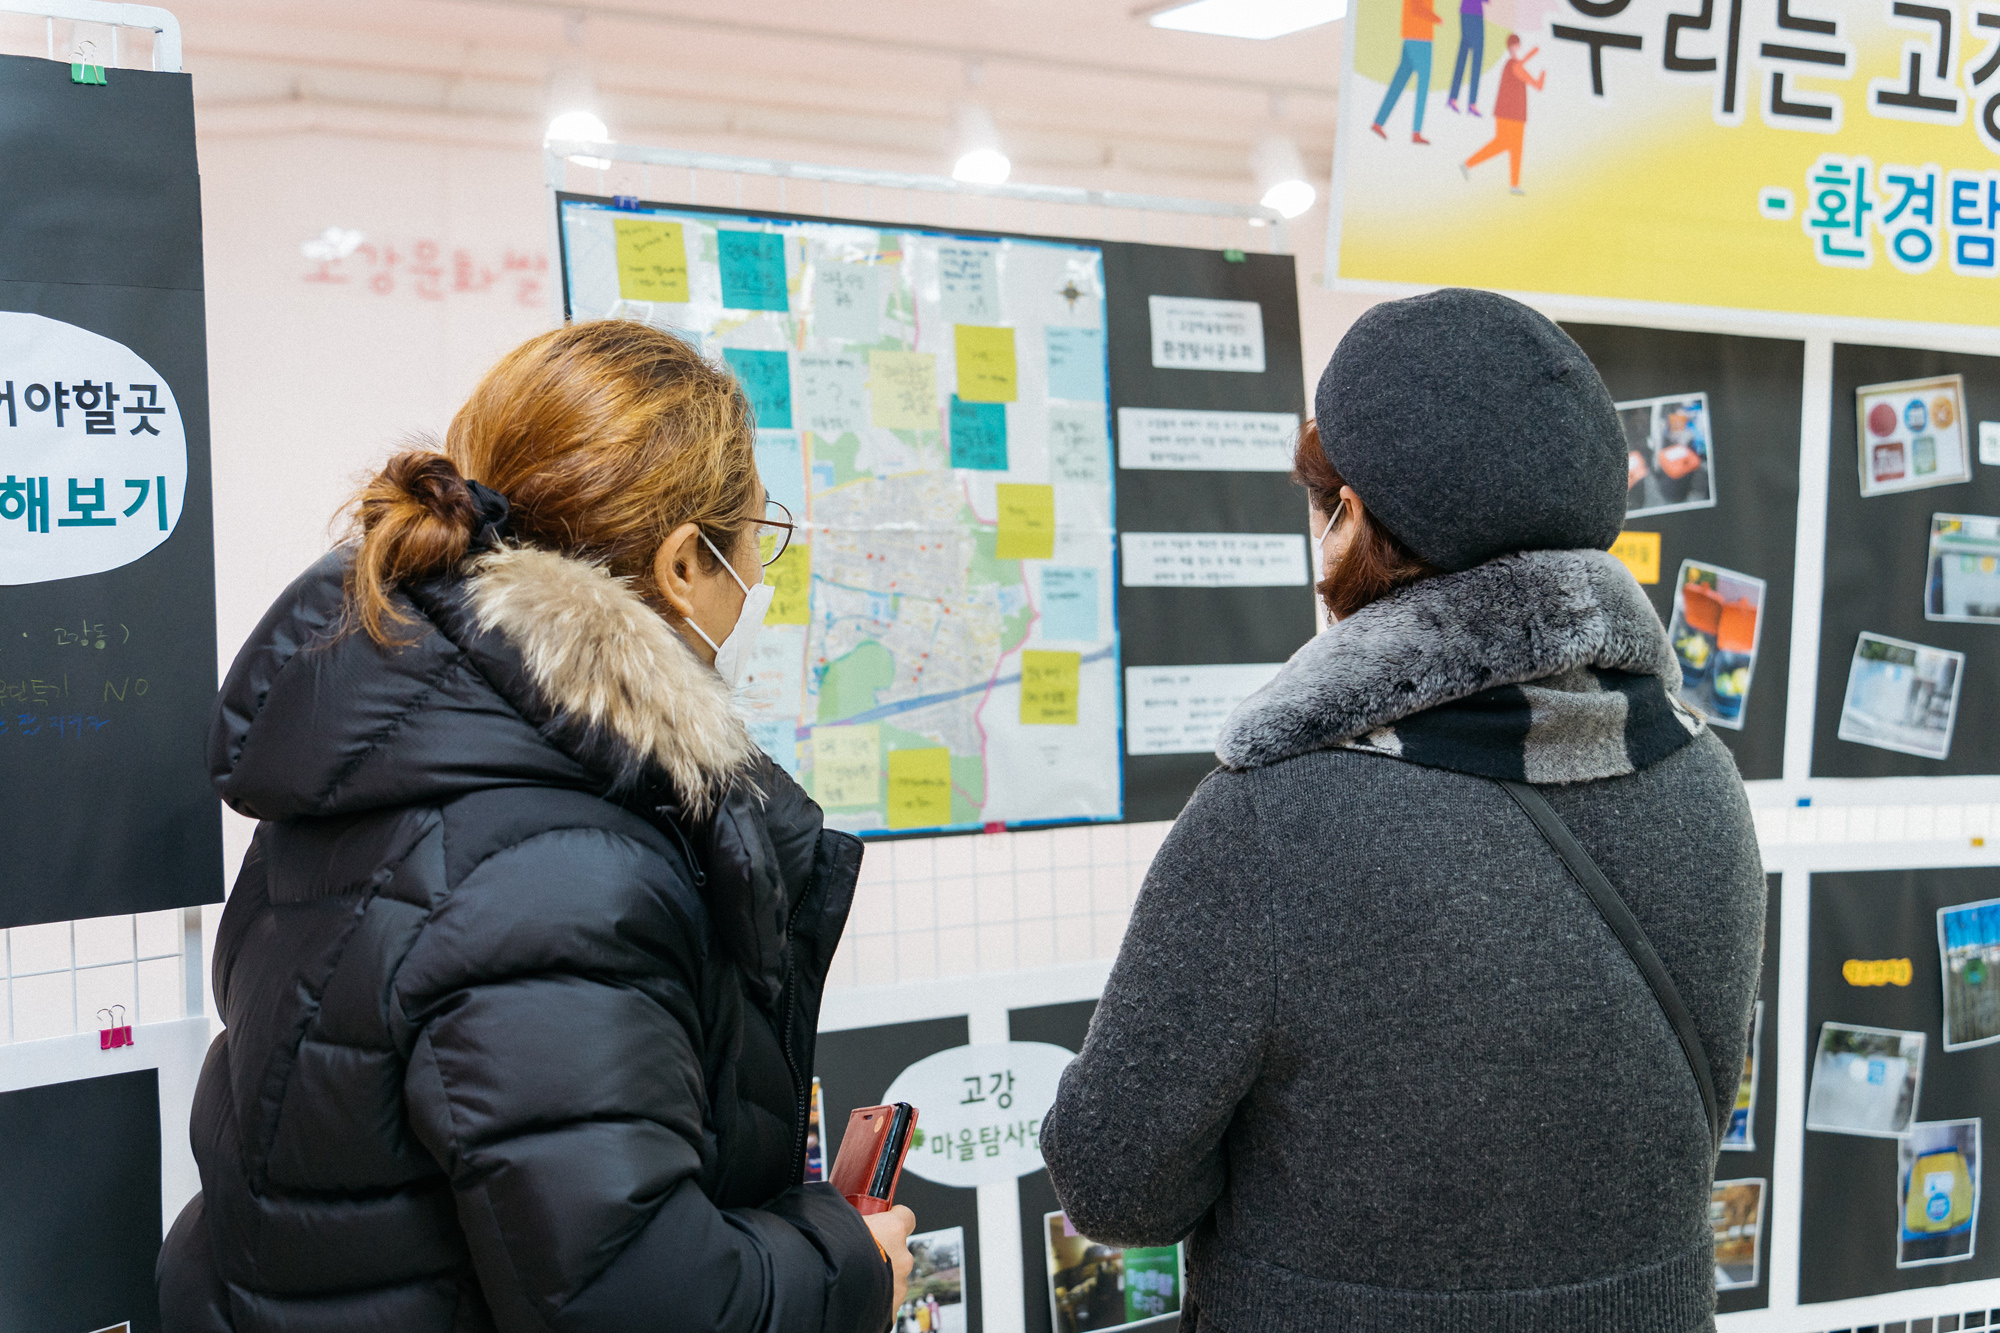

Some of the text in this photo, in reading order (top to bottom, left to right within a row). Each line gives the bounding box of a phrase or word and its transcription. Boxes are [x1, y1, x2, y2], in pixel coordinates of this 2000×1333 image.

[1550, 0, 1846, 121] 우리는
[1811, 164, 2000, 268] 환경탐
[0, 474, 169, 534] 해보기
[103, 676, 150, 703] NO
[959, 1069, 1016, 1110] 고강
